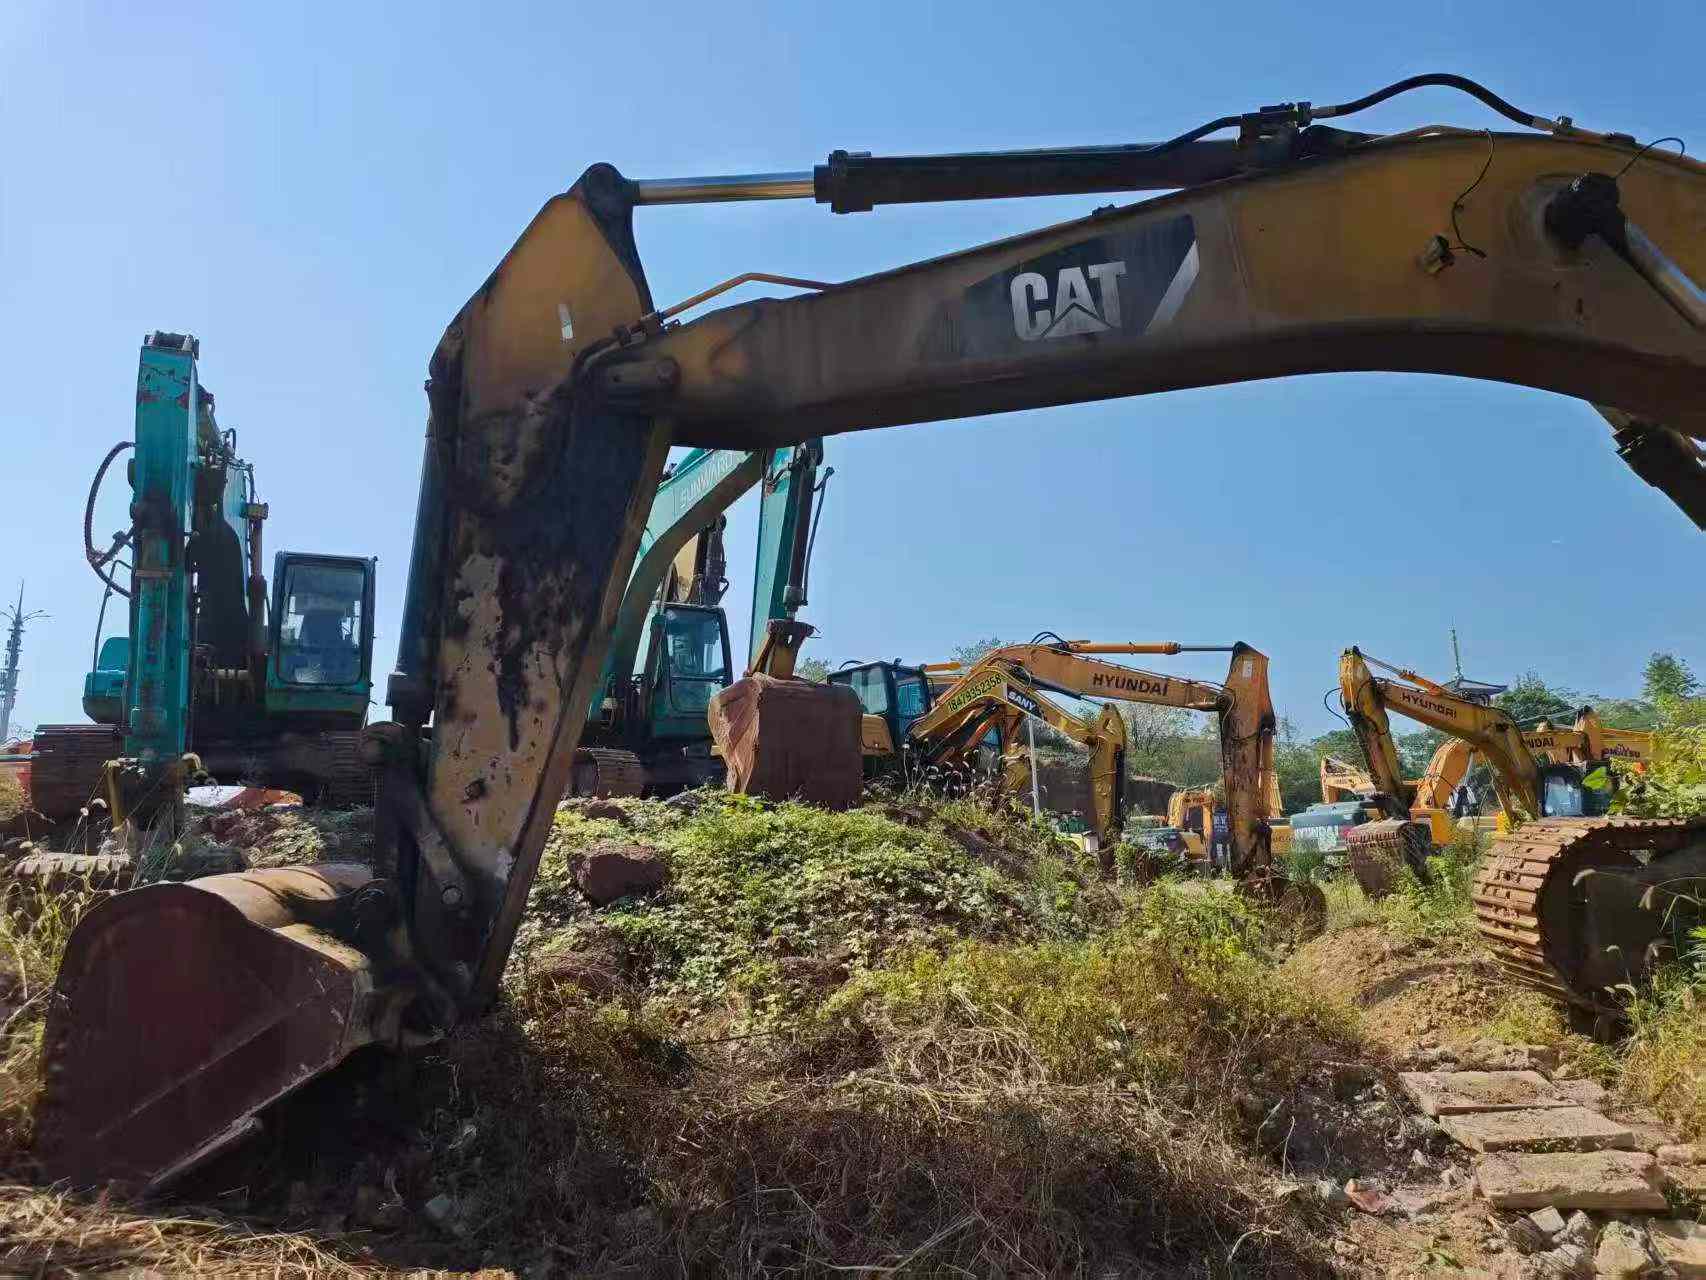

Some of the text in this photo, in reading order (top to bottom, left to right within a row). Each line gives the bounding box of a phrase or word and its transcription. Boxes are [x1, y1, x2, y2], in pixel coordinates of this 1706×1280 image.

[1010, 261, 1126, 341] CAT
[1093, 673, 1169, 696] HYUNDAI
[1008, 691, 1037, 711] SANY
[1401, 692, 1457, 719] HYUNDAI
